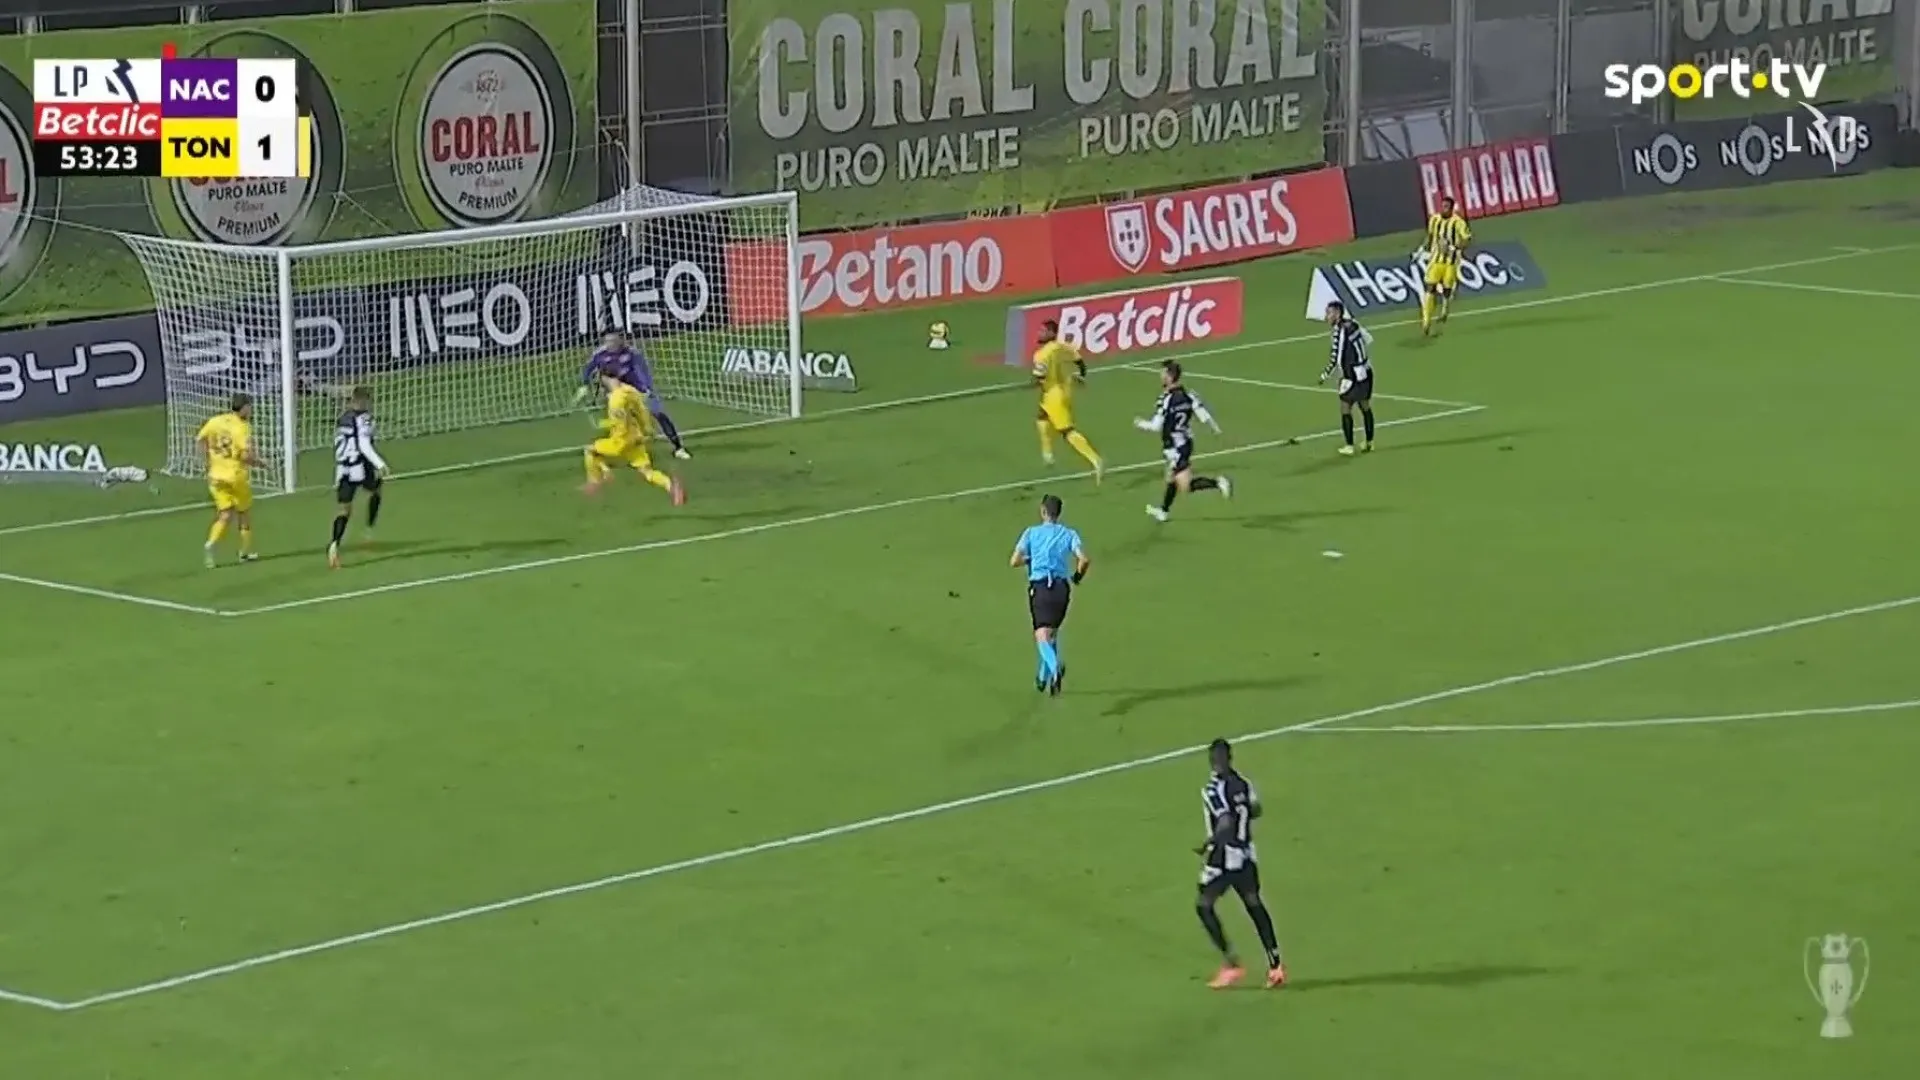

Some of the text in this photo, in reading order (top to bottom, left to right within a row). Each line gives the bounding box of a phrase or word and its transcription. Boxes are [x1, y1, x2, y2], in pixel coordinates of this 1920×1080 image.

[759, 0, 1035, 139] CORAL
[1064, 0, 1316, 104] CORAL
[432, 111, 540, 163] CORAL
[1081, 93, 1300, 158] PURO MALTE
[1721, 125, 1785, 176] NOS
[208, 186, 243, 201] PURO
[246, 180, 287, 197] MALTE
[451, 157, 524, 176] PURO MALTE
[776, 127, 1020, 192] PURO MALTE
[1420, 145, 1556, 214] PLACARD
[1634, 133, 1698, 184] NOS
[217, 212, 280, 236] PREMIUM
[460, 187, 518, 211] PREMIUM
[1155, 180, 1297, 266] SAGRES
[577, 260, 709, 335] MEO
[799, 235, 1002, 312] Betano
[1335, 252, 1508, 312] Heyoc
[389, 282, 532, 358] MEO
[1058, 286, 1217, 353] Betclic
[335, 435, 360, 463] 24
